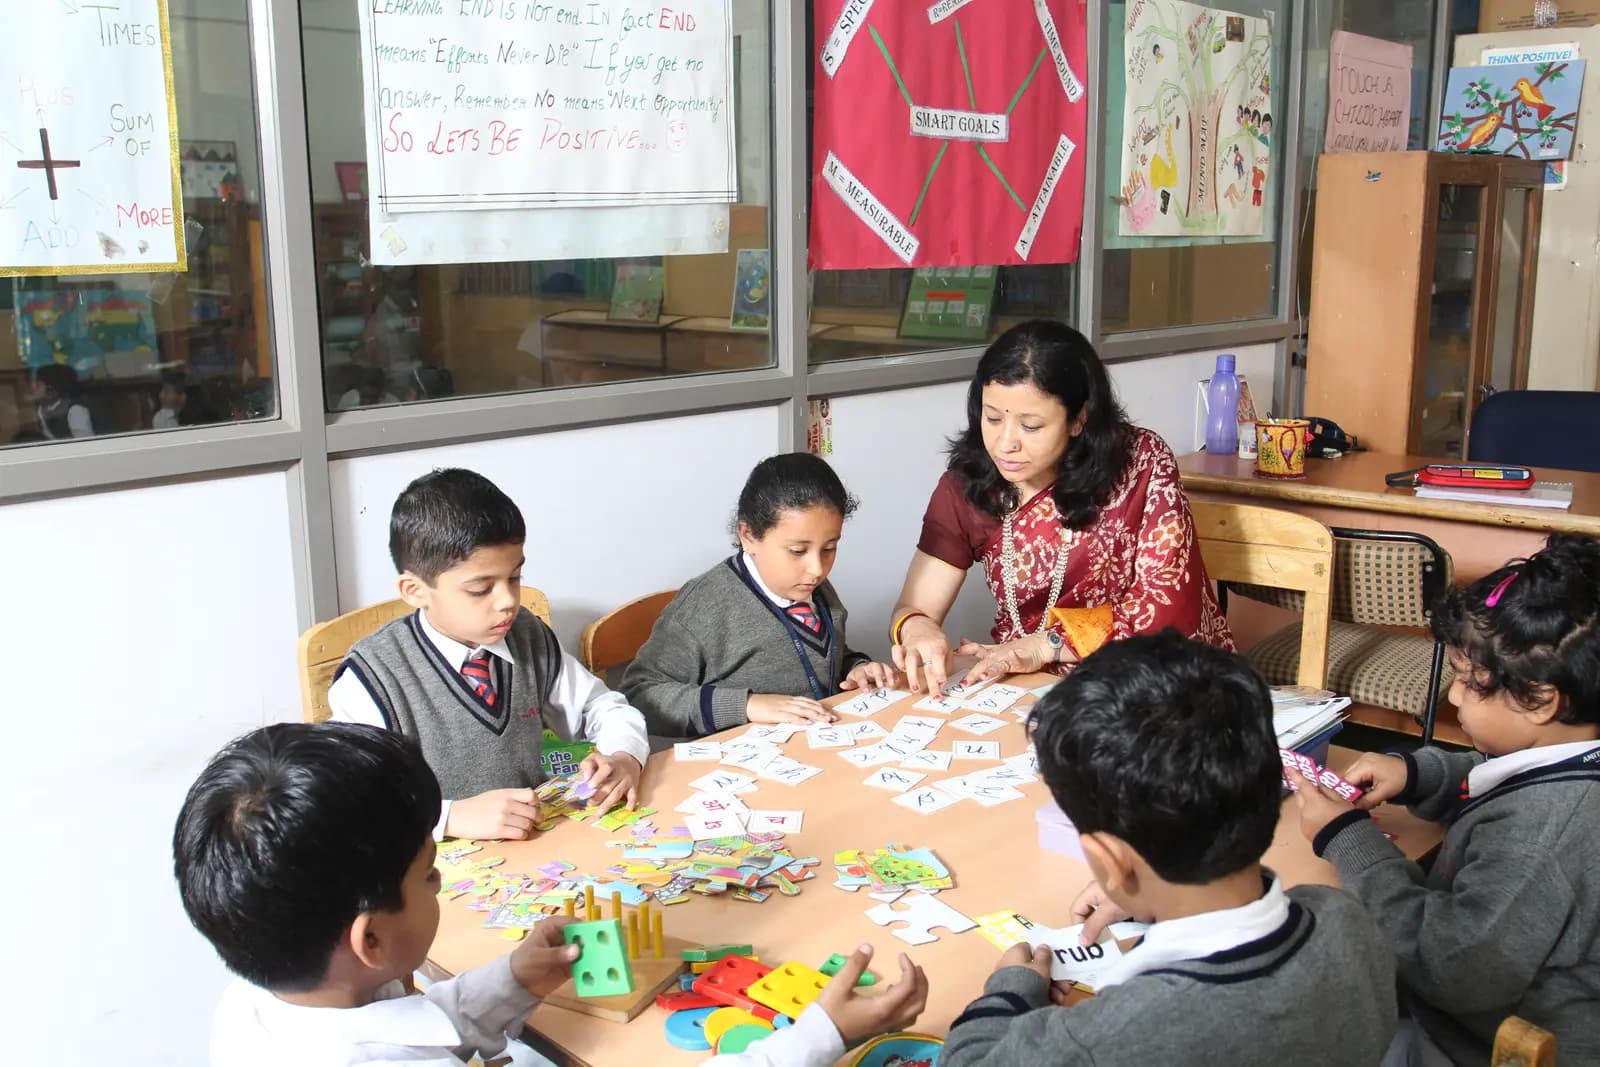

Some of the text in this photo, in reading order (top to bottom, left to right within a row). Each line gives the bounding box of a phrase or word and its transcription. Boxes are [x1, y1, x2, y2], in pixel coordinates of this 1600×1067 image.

[80, 5, 156, 46] TIMES
[525, 2, 553, 22] NOT
[618, 8, 653, 41] fact
[659, 8, 697, 31] END
[376, 44, 427, 63] means
[497, 40, 540, 64] Never
[653, 55, 678, 85] get
[686, 58, 704, 71] no
[1044, 19, 1077, 96] TIME BOUND
[1488, 50, 1572, 65] THINK POSITIVE!
[1337, 66, 1394, 96] TOUCH A
[110, 103, 154, 133] SUM
[563, 96, 605, 110] means
[488, 120, 522, 155] BE
[915, 111, 1000, 135] SMART GOALS
[125, 138, 151, 156] OF
[1032, 140, 1069, 223] ATTAINABLE
[117, 203, 173, 228] MORE
[827, 160, 838, 177] M
[845, 181, 915, 256] MEASURABLE
[22, 220, 80, 251] ADD
[550, 752, 571, 762] the
[552, 763, 578, 774] Far
